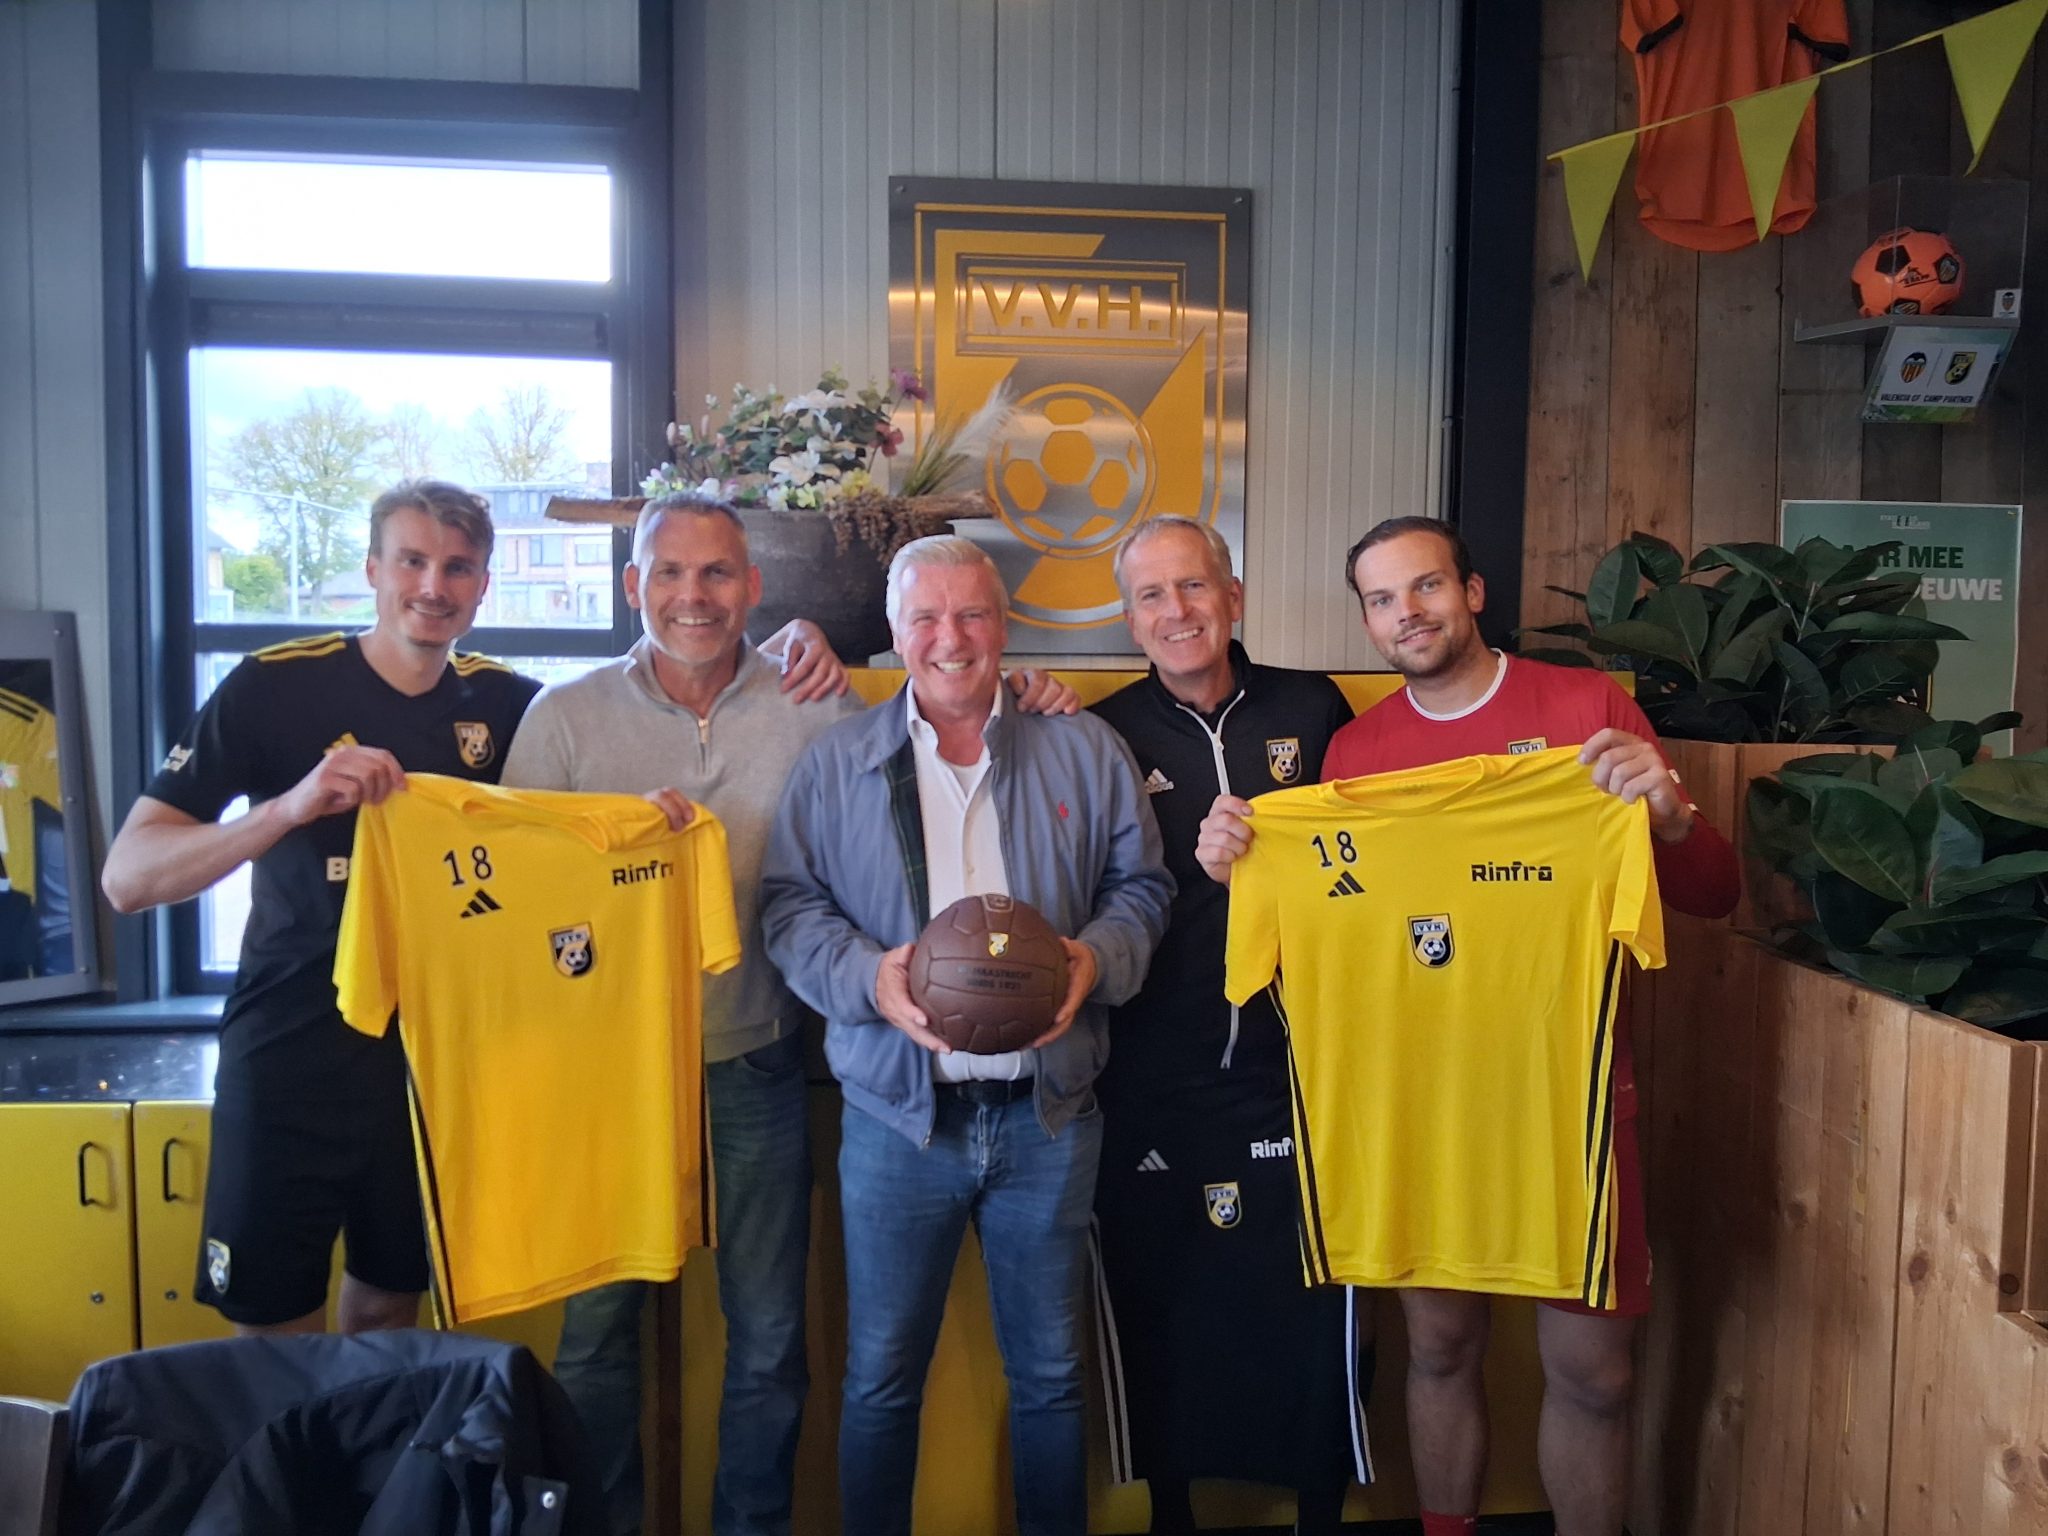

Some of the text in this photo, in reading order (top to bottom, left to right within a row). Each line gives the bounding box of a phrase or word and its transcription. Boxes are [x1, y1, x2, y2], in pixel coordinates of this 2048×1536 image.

[980, 281, 1161, 331] V.V.H.
[1908, 546, 1964, 568] MEE
[1912, 577, 2002, 601] EUWE
[444, 845, 493, 886] 18
[1312, 830, 1357, 867] 18
